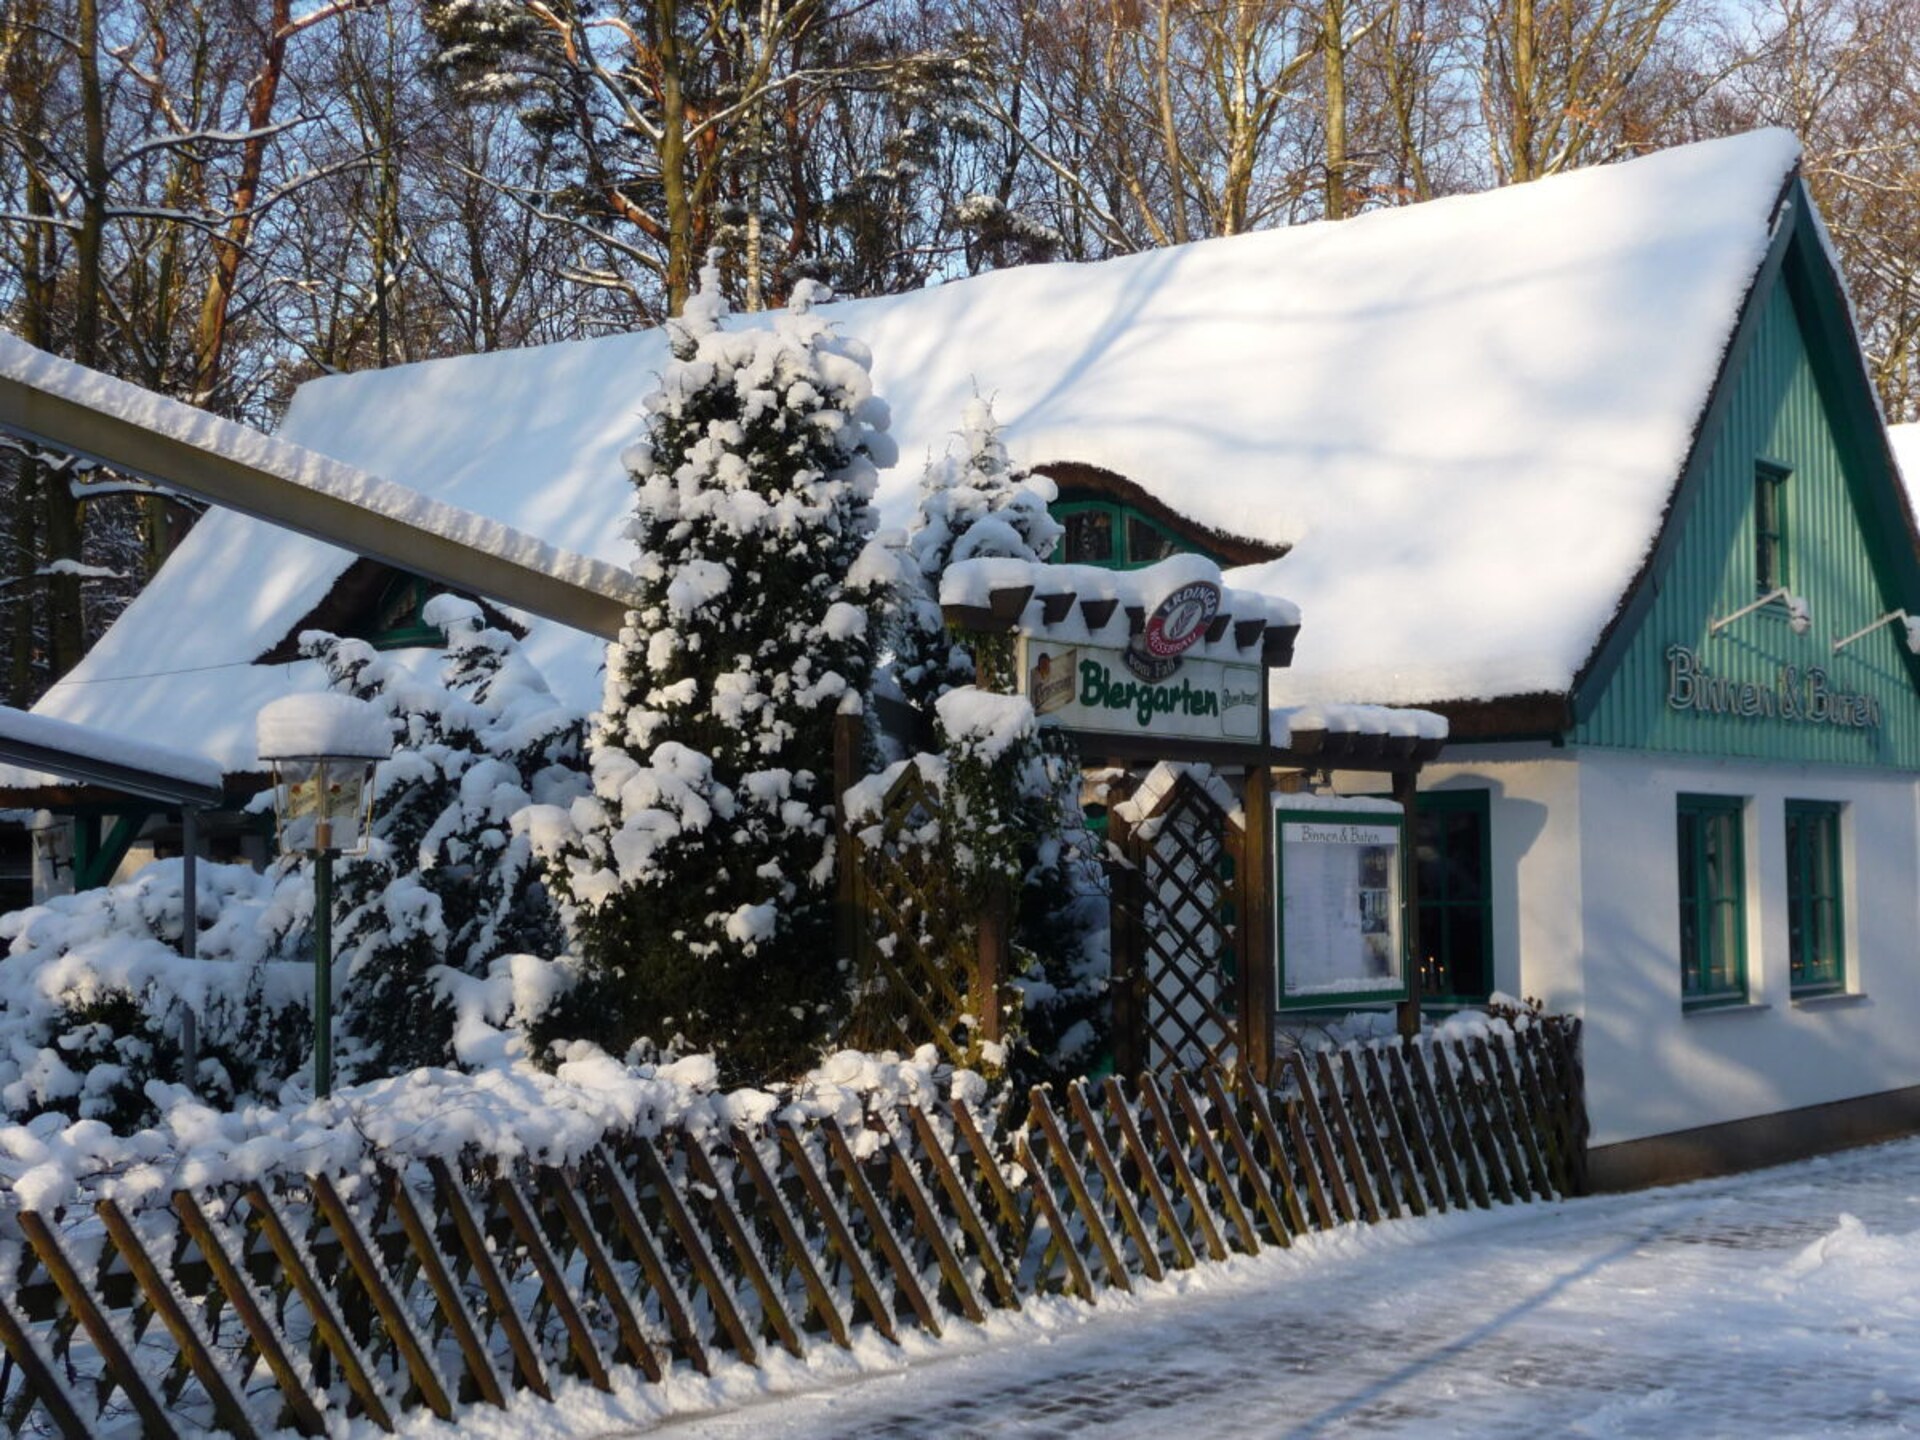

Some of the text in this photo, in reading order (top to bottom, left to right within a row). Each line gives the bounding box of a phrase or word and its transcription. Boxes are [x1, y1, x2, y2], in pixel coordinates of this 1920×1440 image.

[1163, 587, 1217, 618] ERDINGER
[1079, 658, 1219, 727] Biergarten
[1667, 643, 1881, 728] Binnen & Buten
[1301, 825, 1380, 844] Binnen & Buten
